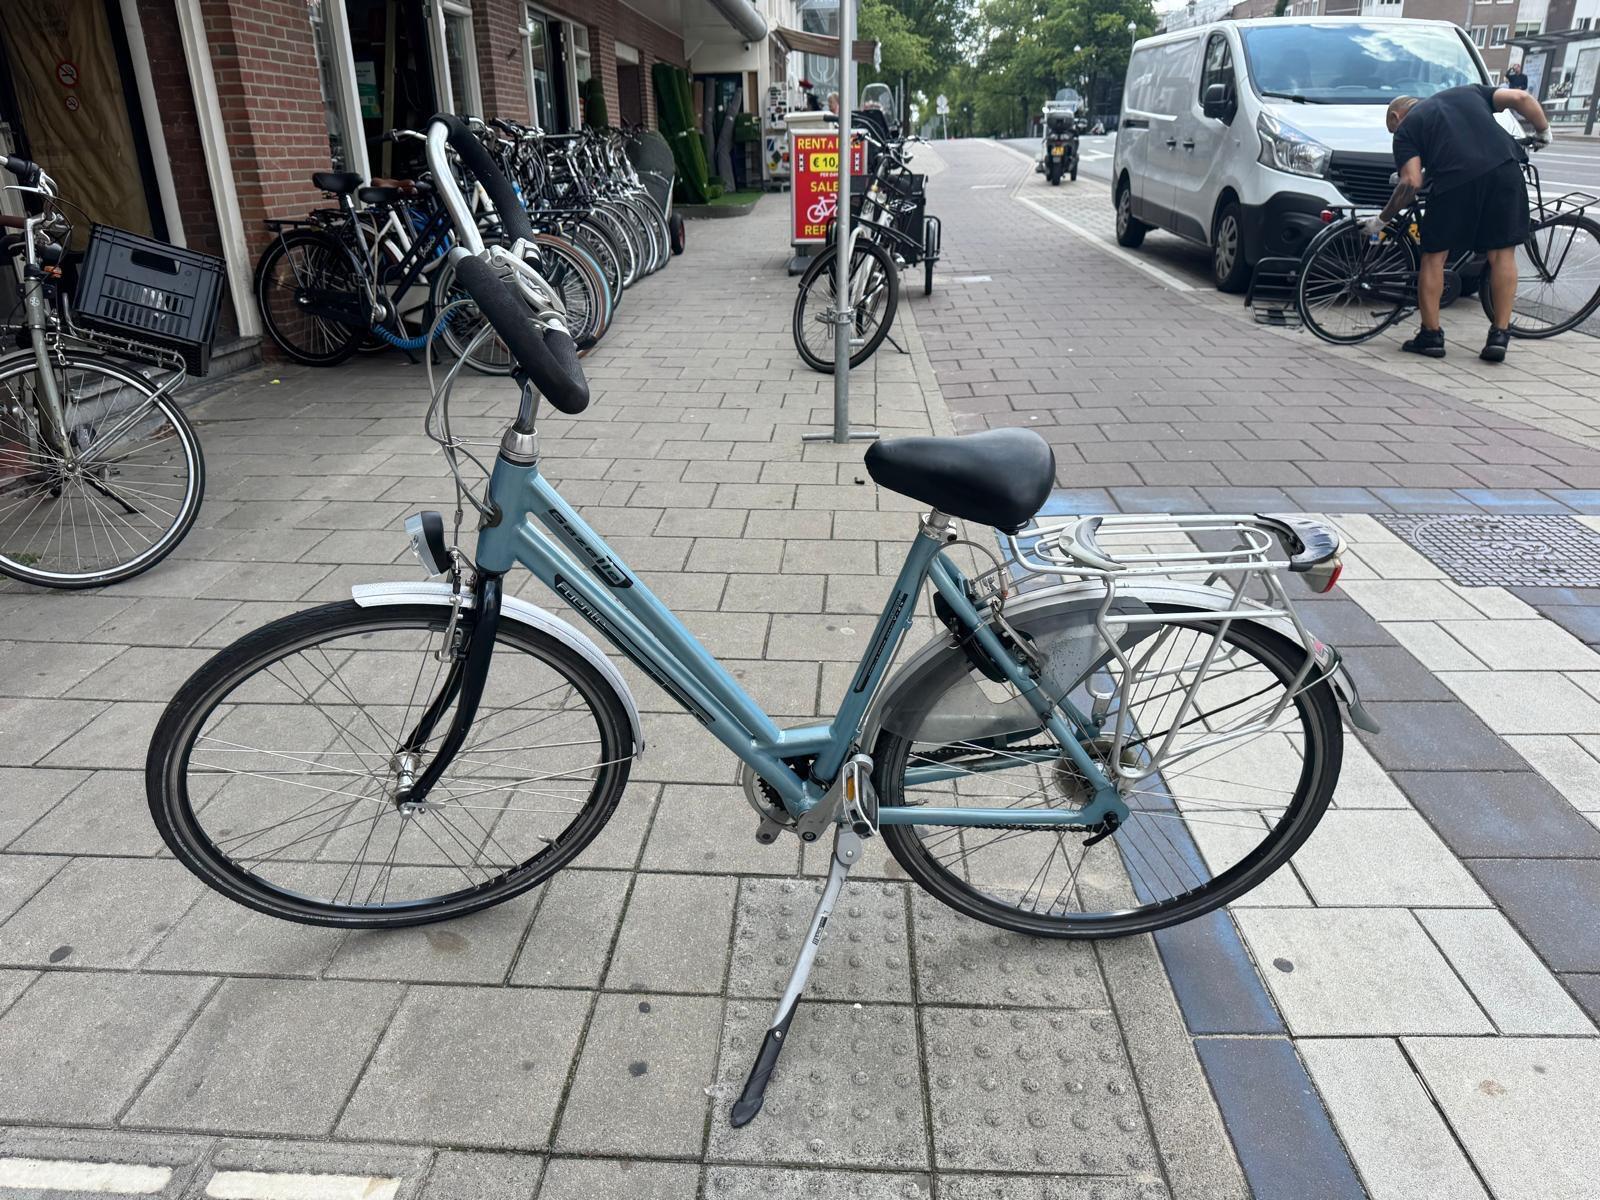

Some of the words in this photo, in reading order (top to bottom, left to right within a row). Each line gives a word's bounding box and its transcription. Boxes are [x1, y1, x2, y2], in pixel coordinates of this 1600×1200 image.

[797, 138, 827, 149] RENT
[827, 140, 834, 149] A
[813, 157, 820, 168] €
[804, 225, 827, 236] REP
[550, 509, 622, 582] Gazelle
[556, 582, 608, 630] Fuente
